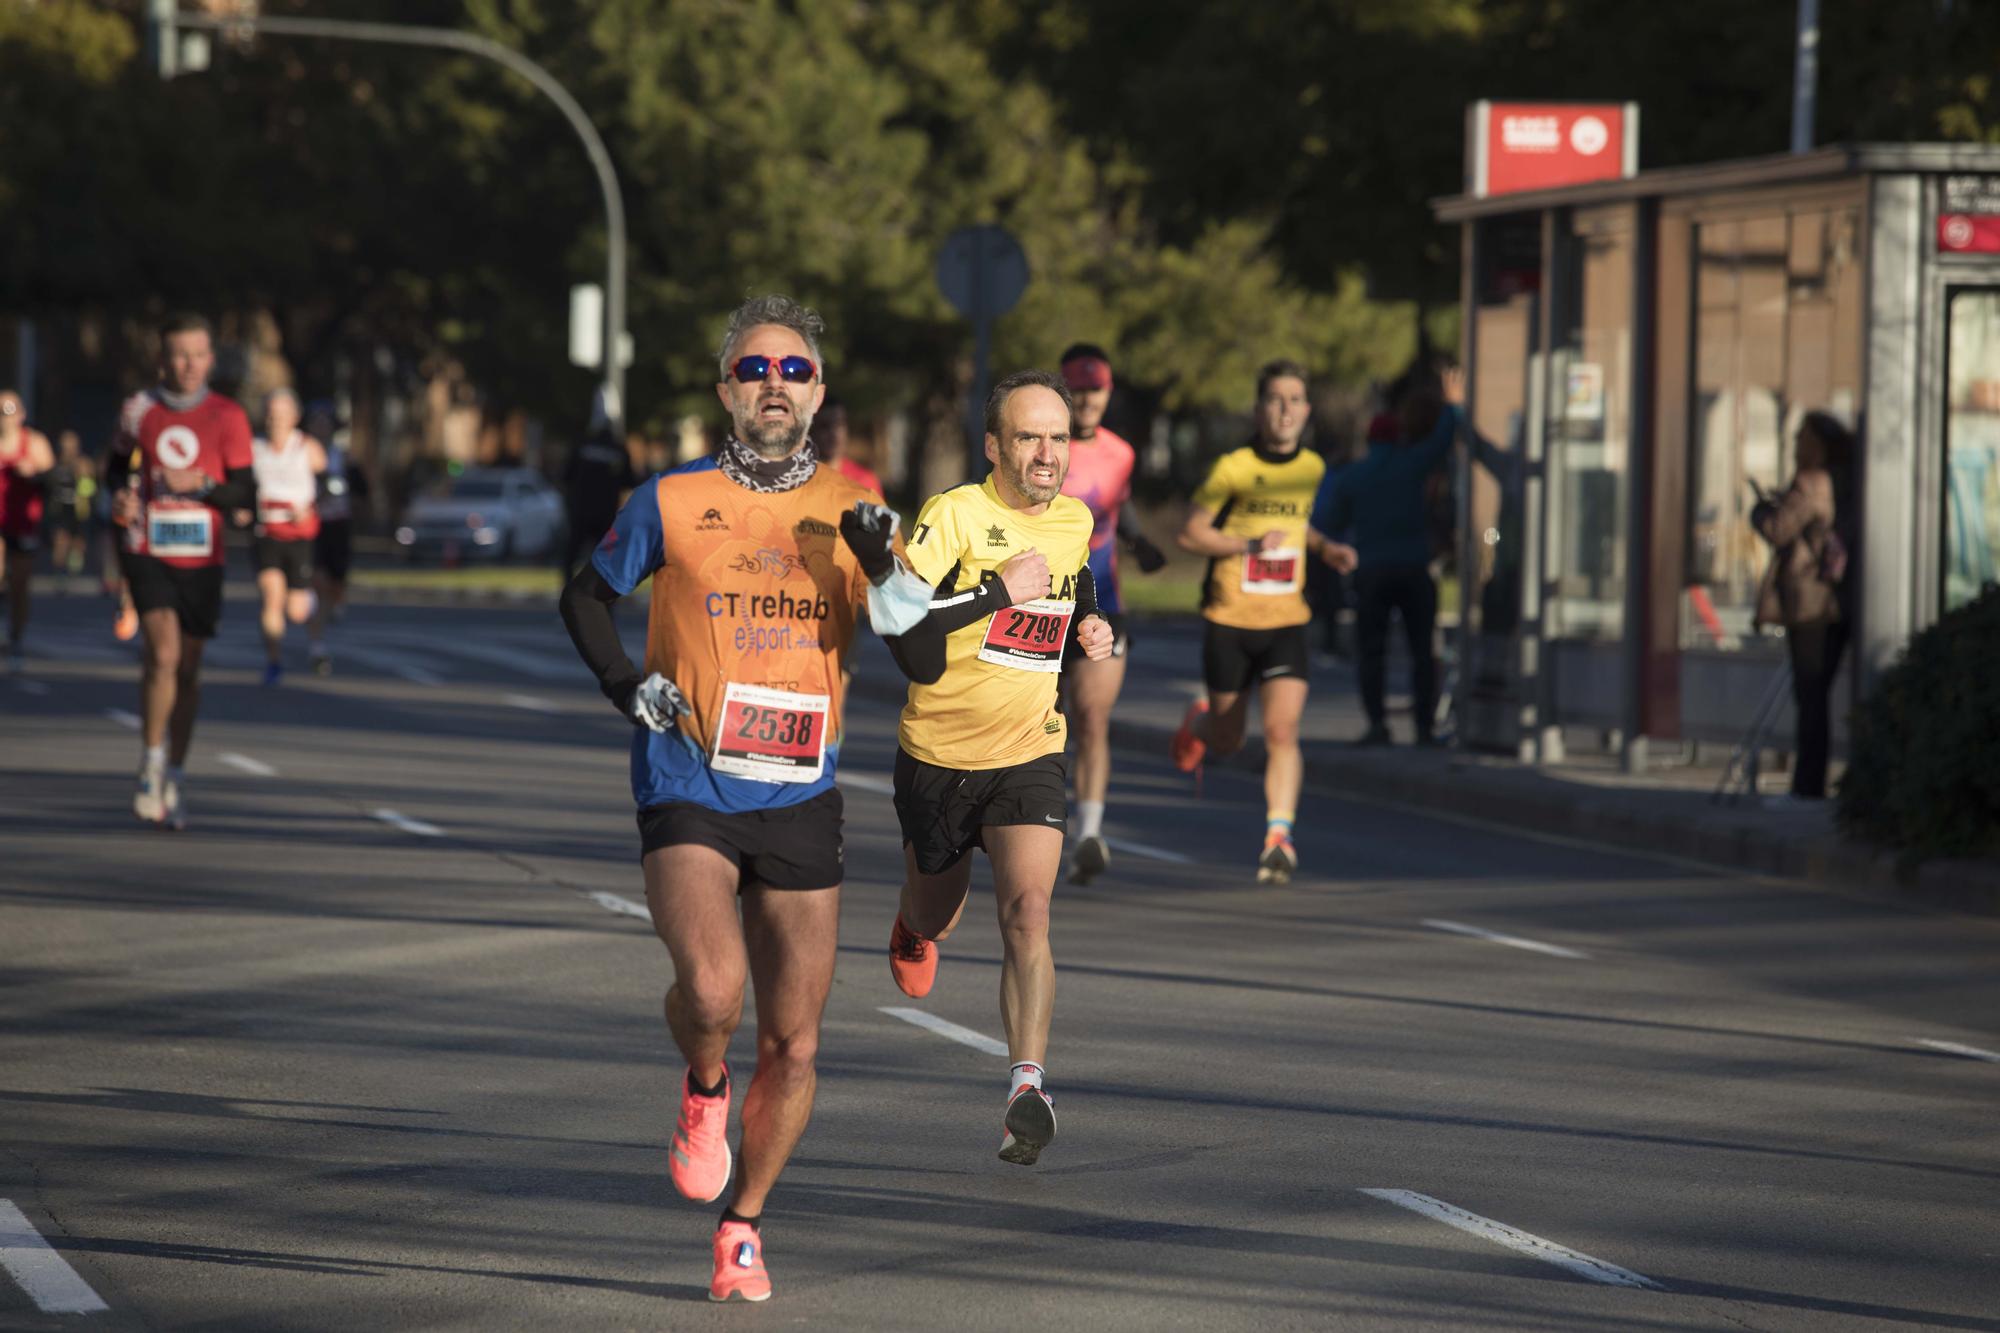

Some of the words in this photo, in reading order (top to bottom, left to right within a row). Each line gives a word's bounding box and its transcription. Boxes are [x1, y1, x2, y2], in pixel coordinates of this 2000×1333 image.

[705, 592, 741, 617] CT
[751, 590, 828, 621] rehab
[1004, 611, 1062, 644] 2798
[737, 706, 813, 746] 2538
